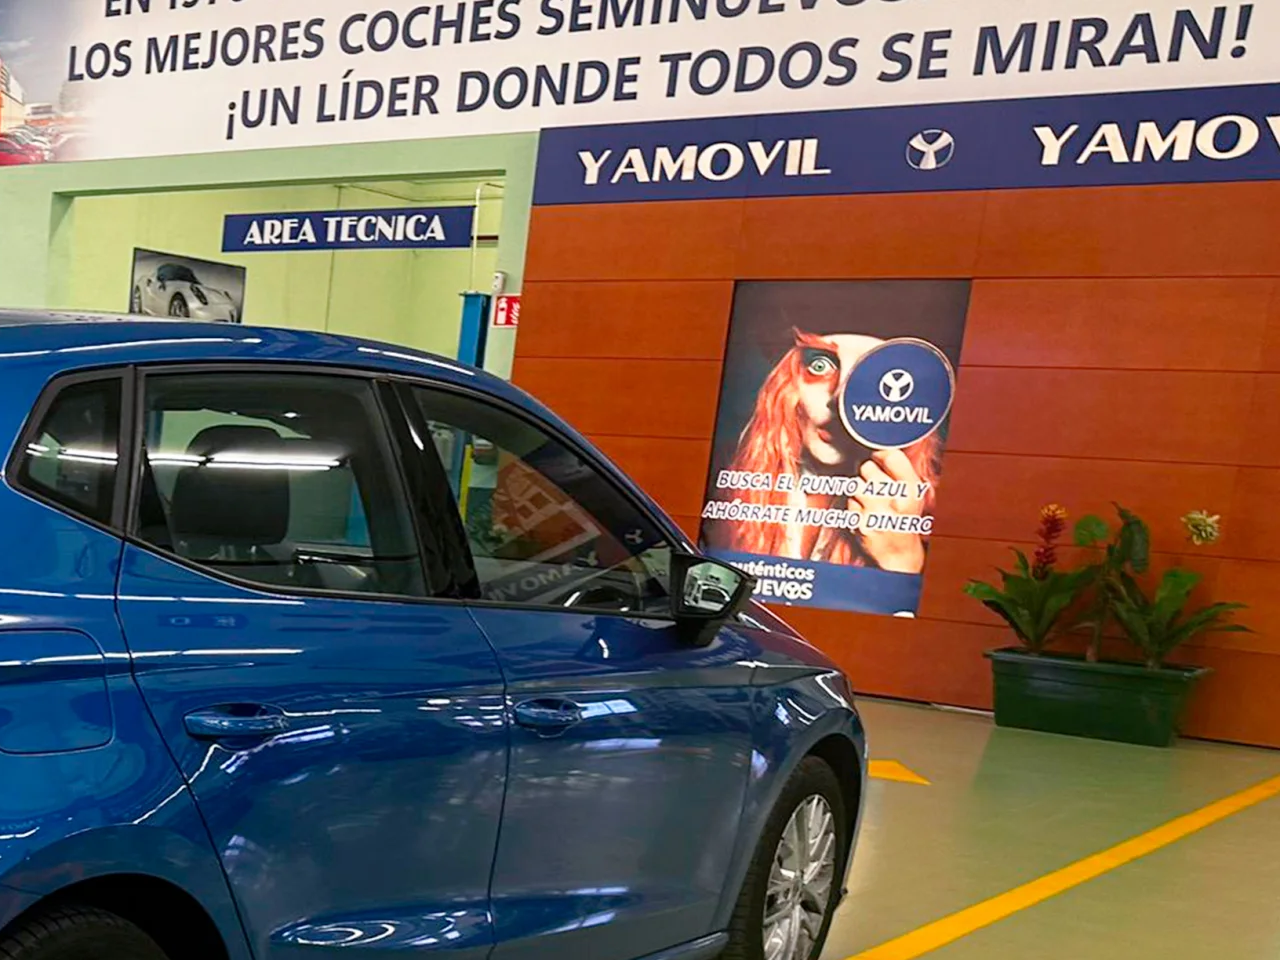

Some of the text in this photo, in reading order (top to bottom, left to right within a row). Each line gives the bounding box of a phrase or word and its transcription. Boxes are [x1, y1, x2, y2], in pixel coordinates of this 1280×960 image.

[68, 39, 132, 81] LOS
[145, 18, 325, 74] MEJORES
[339, 0, 520, 55] COCHES
[225, 3, 1254, 140] ¡UN LÍDER DONDE TODOS SE MIRAN!
[578, 138, 832, 185] YAMOVIL
[243, 214, 446, 246] AREA TECNICA
[852, 404, 934, 425] YAMOVIL
[717, 472, 929, 500] BUSCA EL PUNTO AZUL Y
[703, 499, 934, 534] AHÓRRATE MUCHO DINERO
